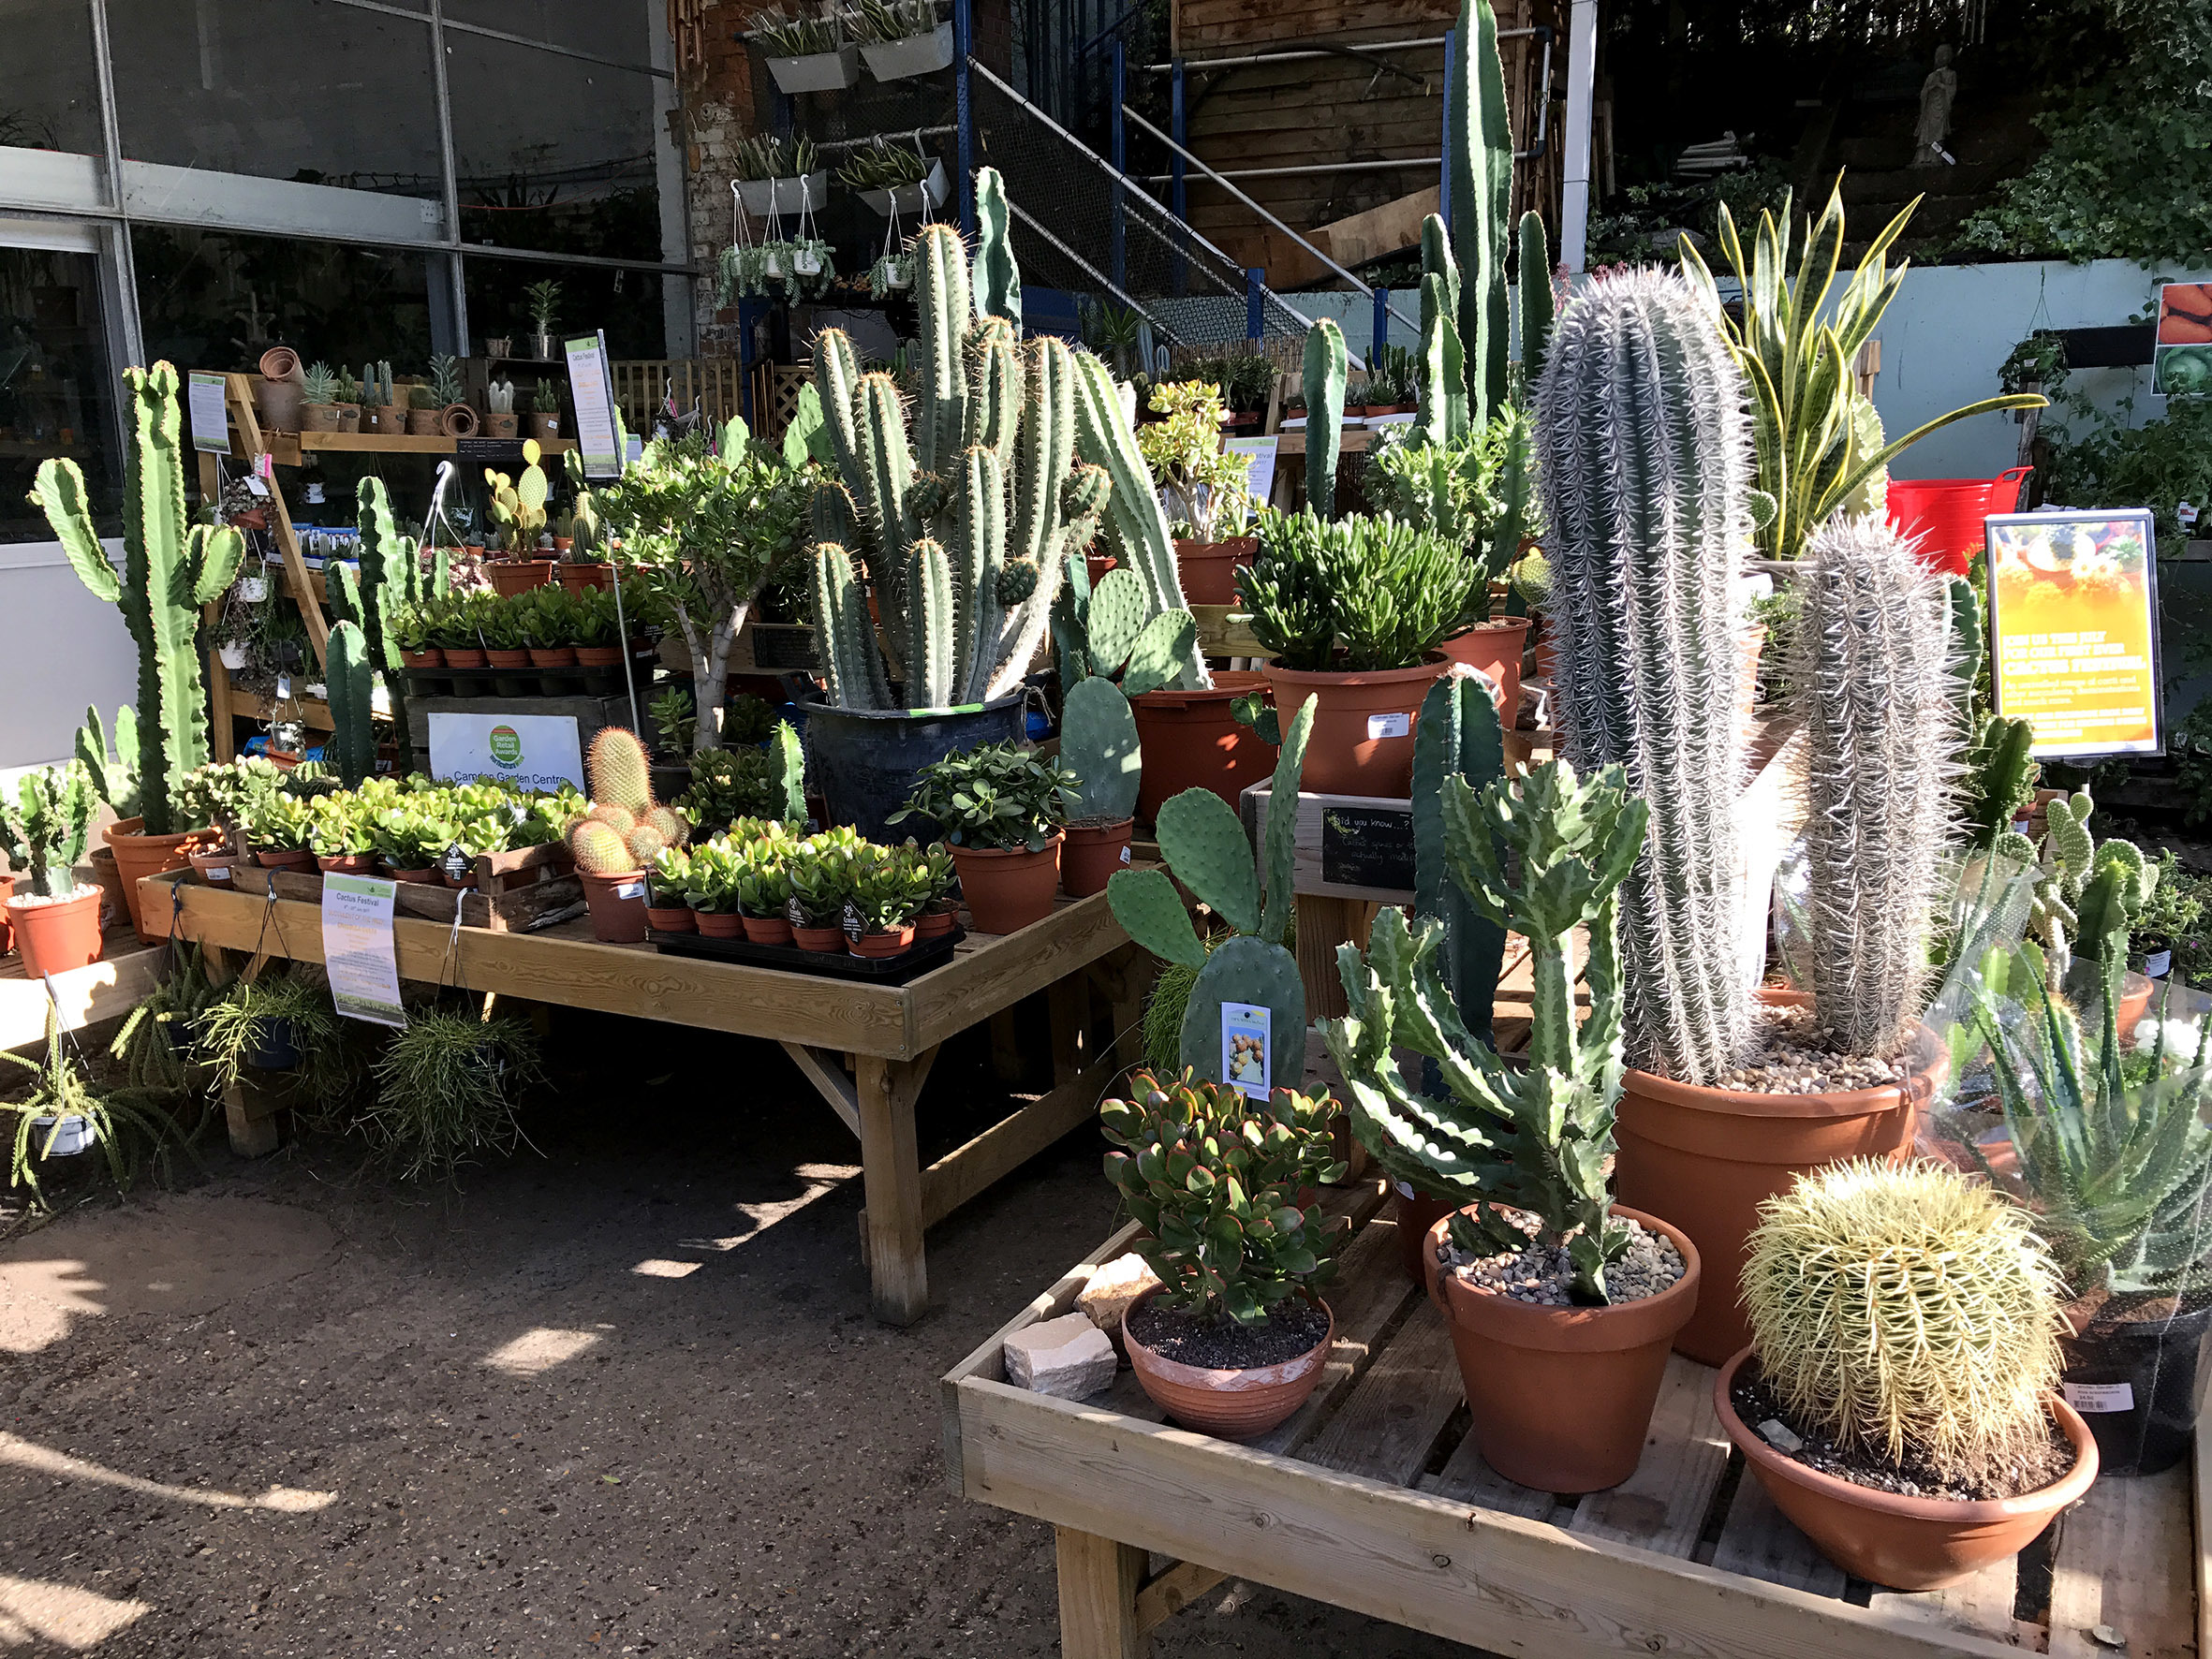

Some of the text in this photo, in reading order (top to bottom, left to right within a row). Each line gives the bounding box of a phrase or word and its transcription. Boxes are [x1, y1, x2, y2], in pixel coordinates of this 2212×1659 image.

[496, 771, 530, 784] Gaden
[336, 892, 379, 907] Cactus Festival
